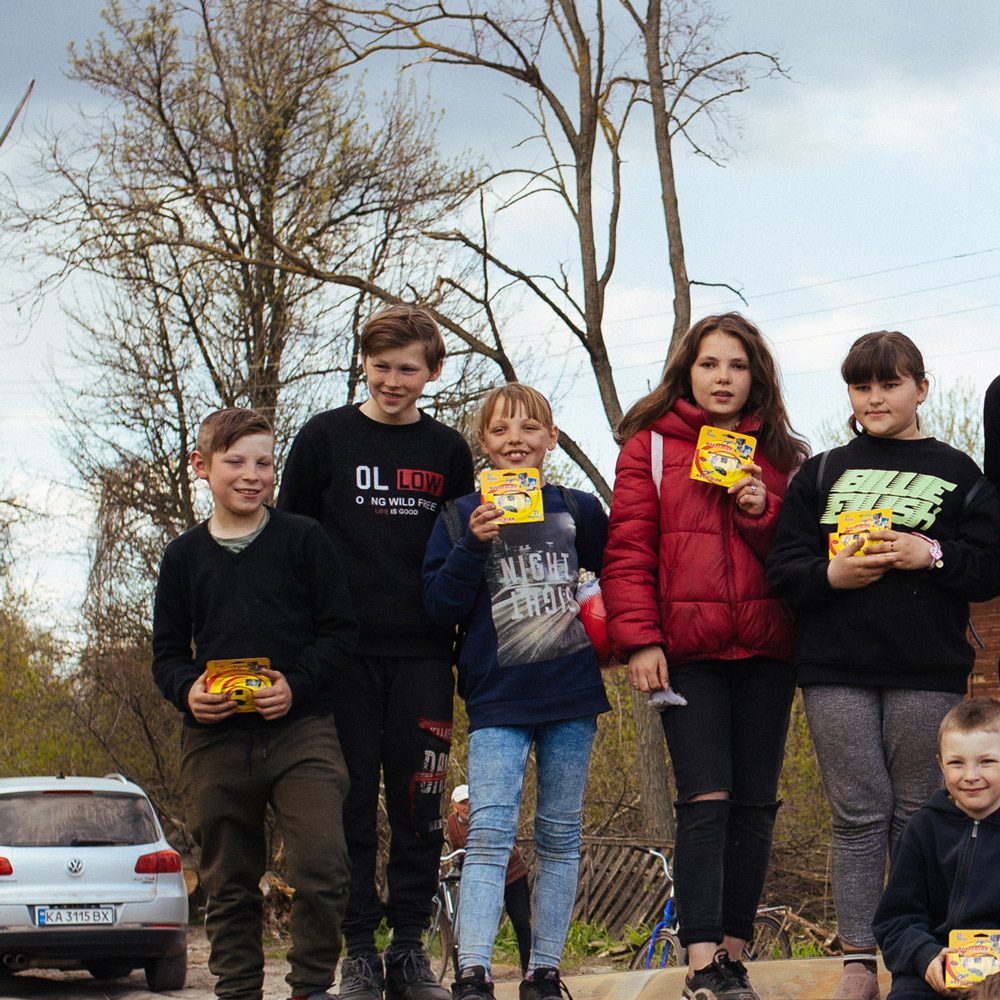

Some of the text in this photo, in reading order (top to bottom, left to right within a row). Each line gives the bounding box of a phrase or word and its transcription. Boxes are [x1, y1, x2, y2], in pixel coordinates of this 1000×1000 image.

[399, 471, 442, 495] LOW
[829, 468, 957, 506] BILLIE
[389, 498, 415, 507] WILD
[418, 499, 437, 512] FREE
[500, 552, 570, 585] NIGHT
[46, 911, 109, 922] KA 3115 BX
